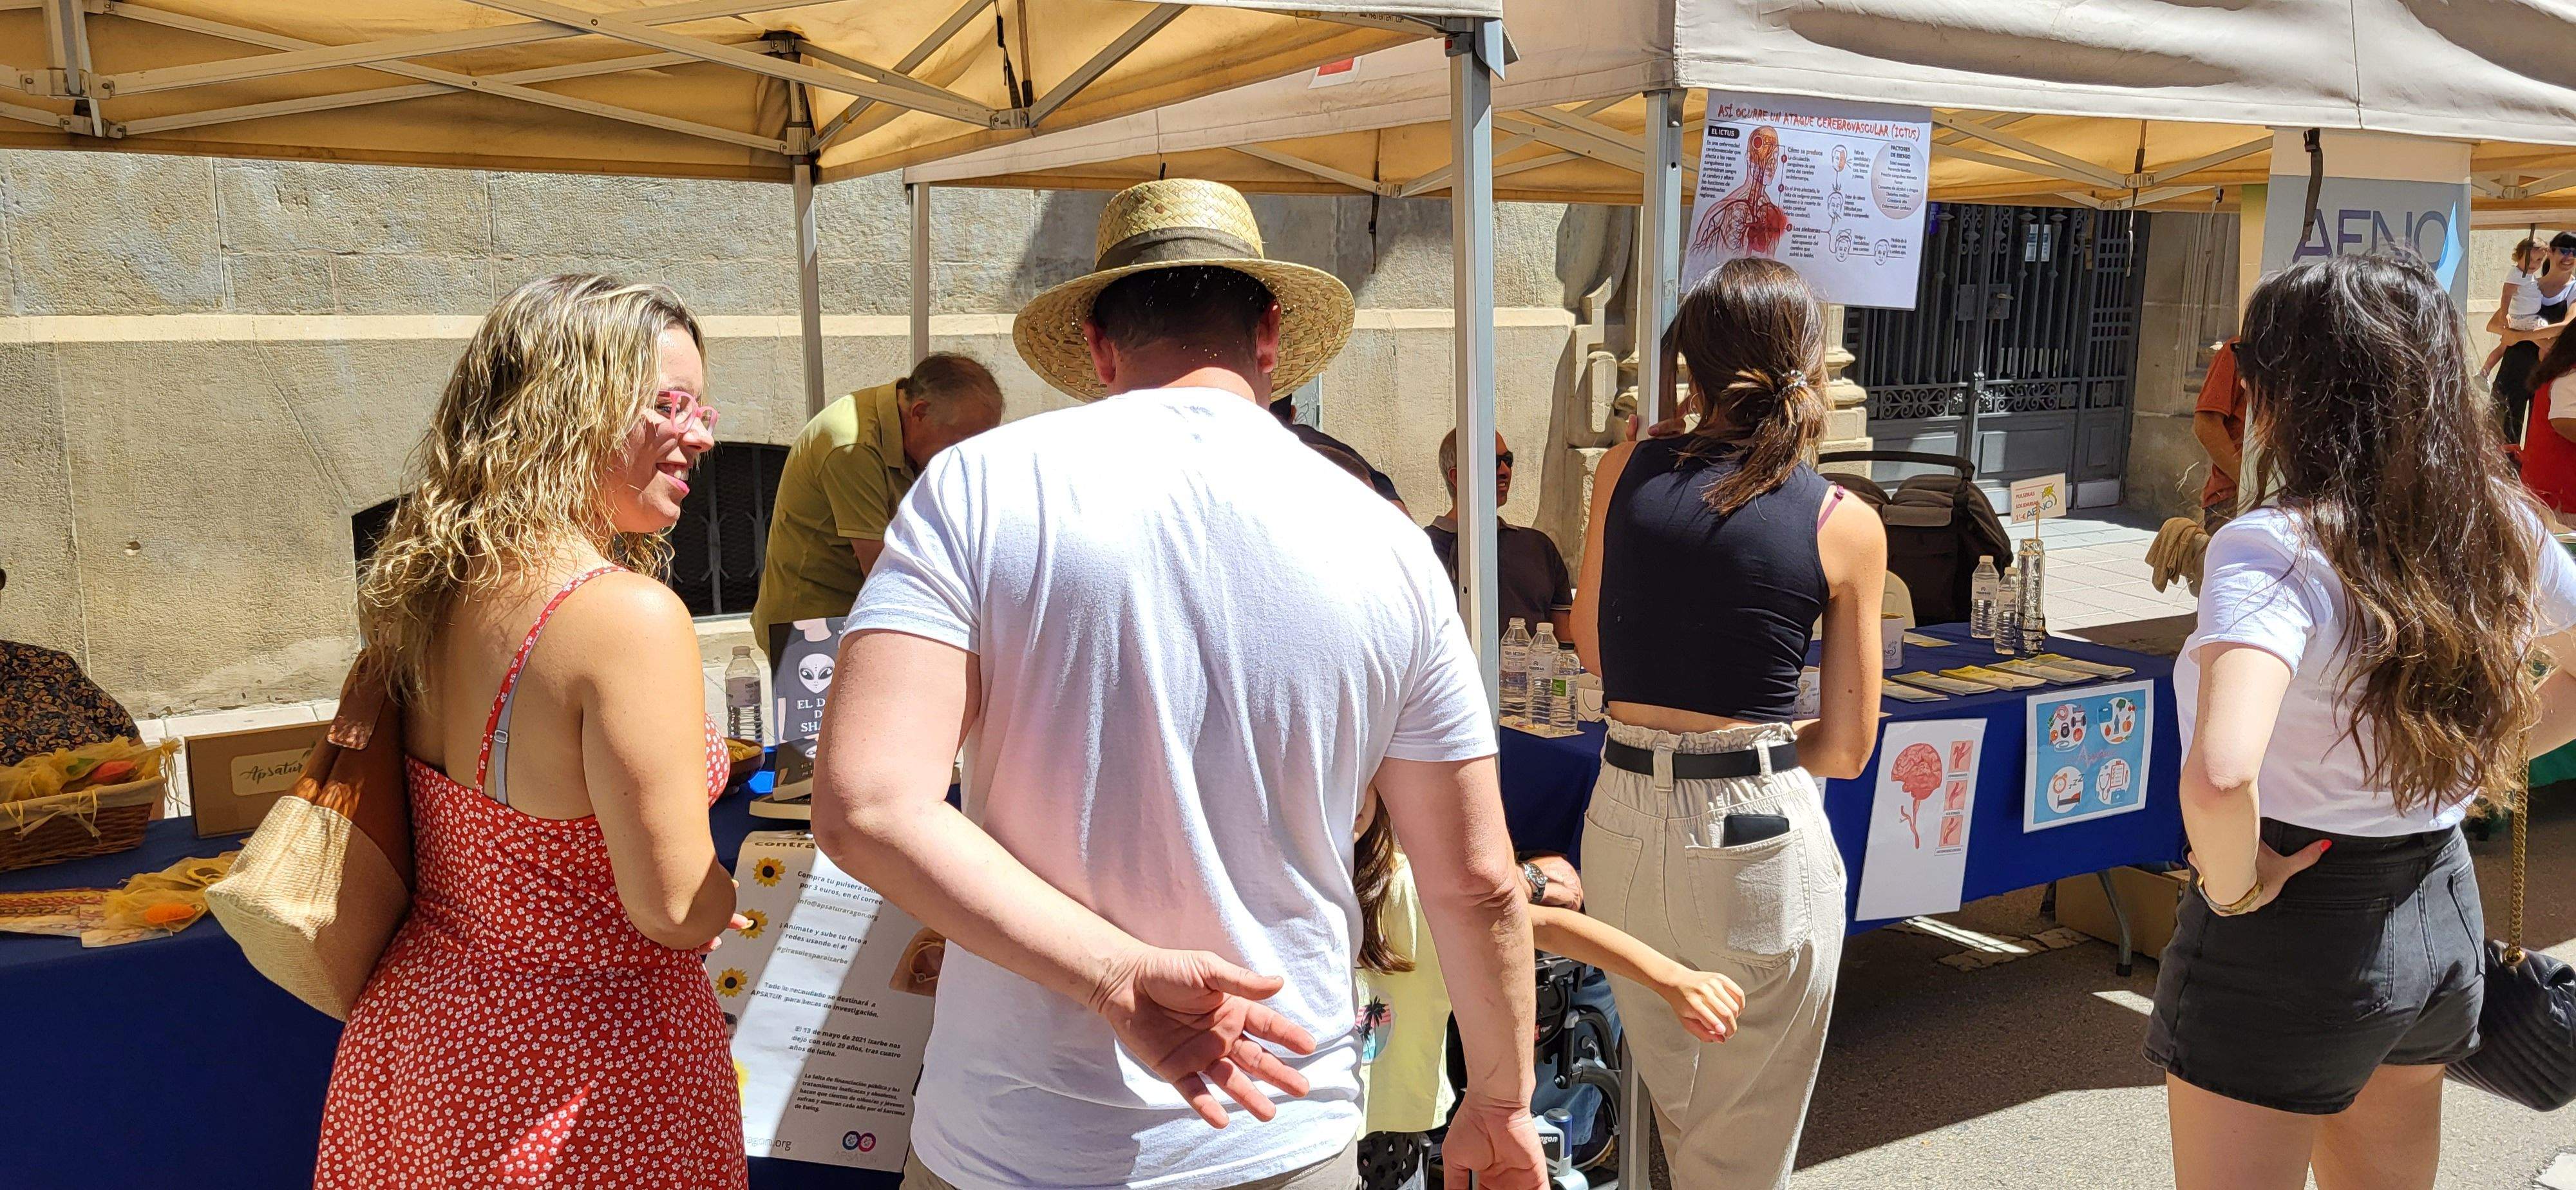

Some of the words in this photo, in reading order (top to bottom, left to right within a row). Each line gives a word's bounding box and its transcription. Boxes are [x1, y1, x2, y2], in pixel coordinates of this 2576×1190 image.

[1719, 129, 1735, 137] ICTUS
[1770, 111, 1781, 122] UN
[1783, 112, 1814, 127] ATAQUE
[1816, 117, 1889, 137] CEREBROVASCULAR
[1891, 123, 1920, 142] (ICTUS)
[797, 699, 813, 710] EL
[239, 760, 303, 785] Apsatur
[755, 841, 815, 849] contra
[798, 871, 825, 882] Compra
[835, 881, 862, 891] pulsera
[819, 886, 840, 897] euros,
[860, 897, 883, 905] correo
[798, 898, 879, 922] info@apsaturaragon.org
[785, 933, 804, 941] redes
[805, 938, 831, 947] usando
[765, 982, 781, 990] Todo
[790, 987, 826, 999] recaudado
[837, 995, 869, 1006] destinará
[750, 990, 782, 1001] APSATUR
[802, 998, 822, 1008] becas
[833, 1003, 879, 1018] investigación.
[822, 1031, 841, 1039] mayo
[868, 1038, 888, 1047] Izarbe
[817, 1048, 837, 1057] lucha.
[846, 1044, 864, 1053] años,
[802, 1081, 838, 1090] tratamientos
[839, 1086, 866, 1095] ineficaces
[802, 1104, 820, 1113] Ewing.
